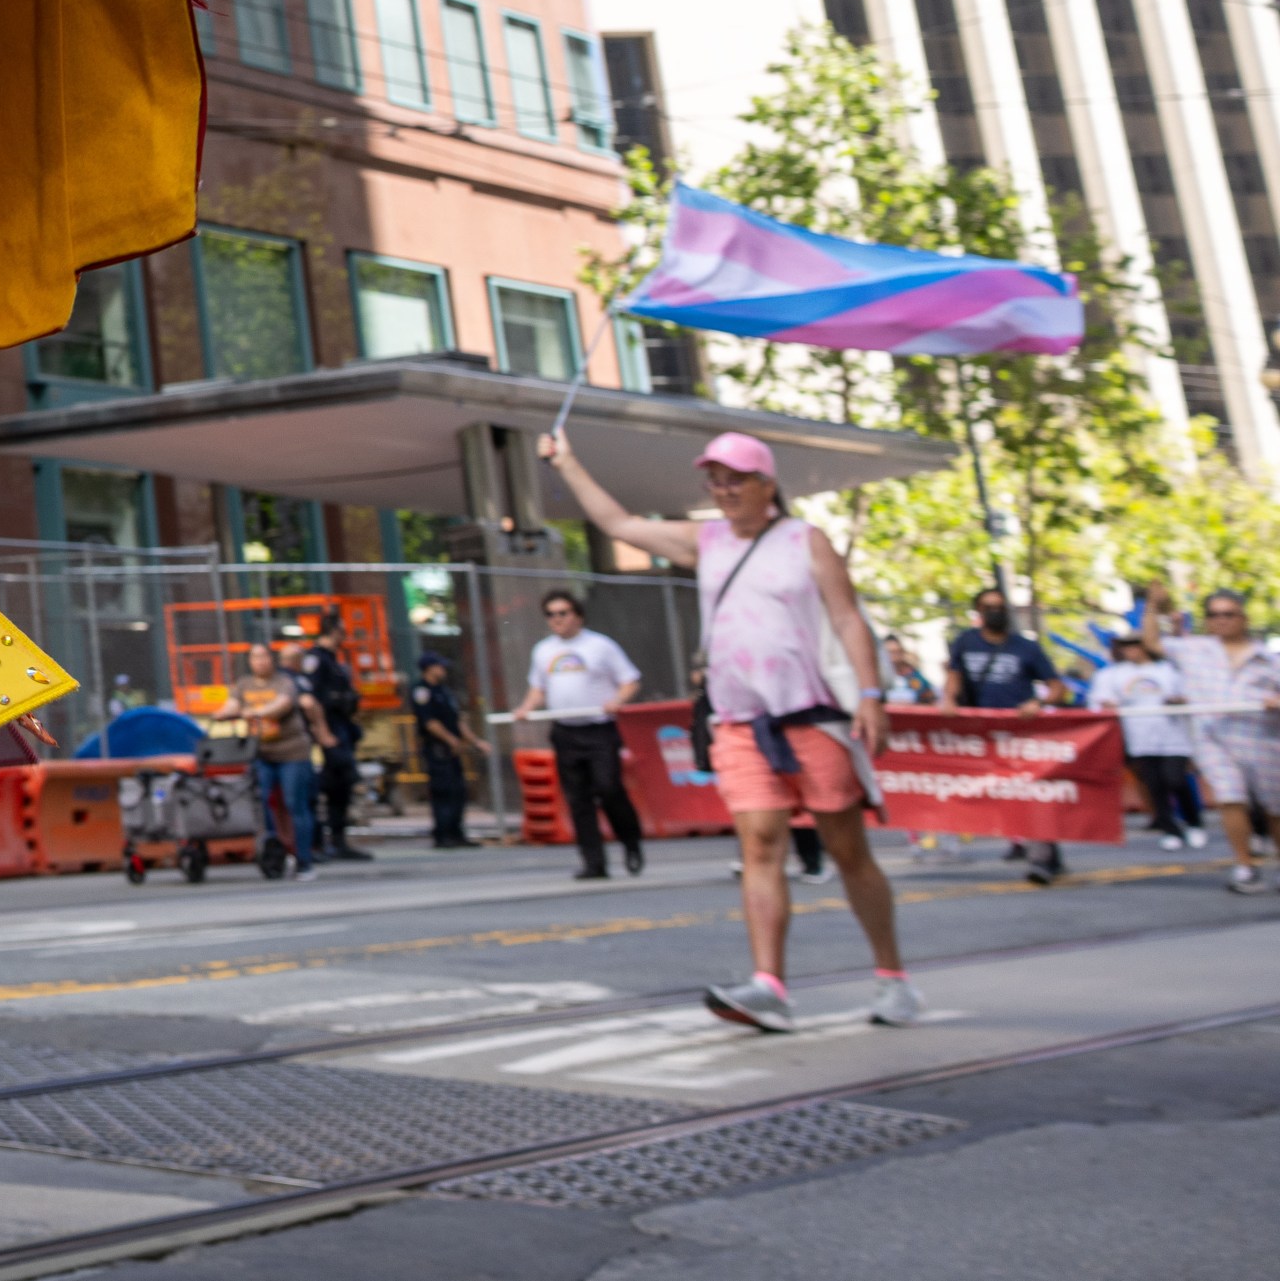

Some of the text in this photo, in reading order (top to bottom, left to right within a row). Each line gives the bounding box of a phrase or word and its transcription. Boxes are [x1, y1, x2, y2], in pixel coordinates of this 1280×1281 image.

[886, 730, 1077, 763] ut the Trans
[878, 771, 1080, 803] ansportation
